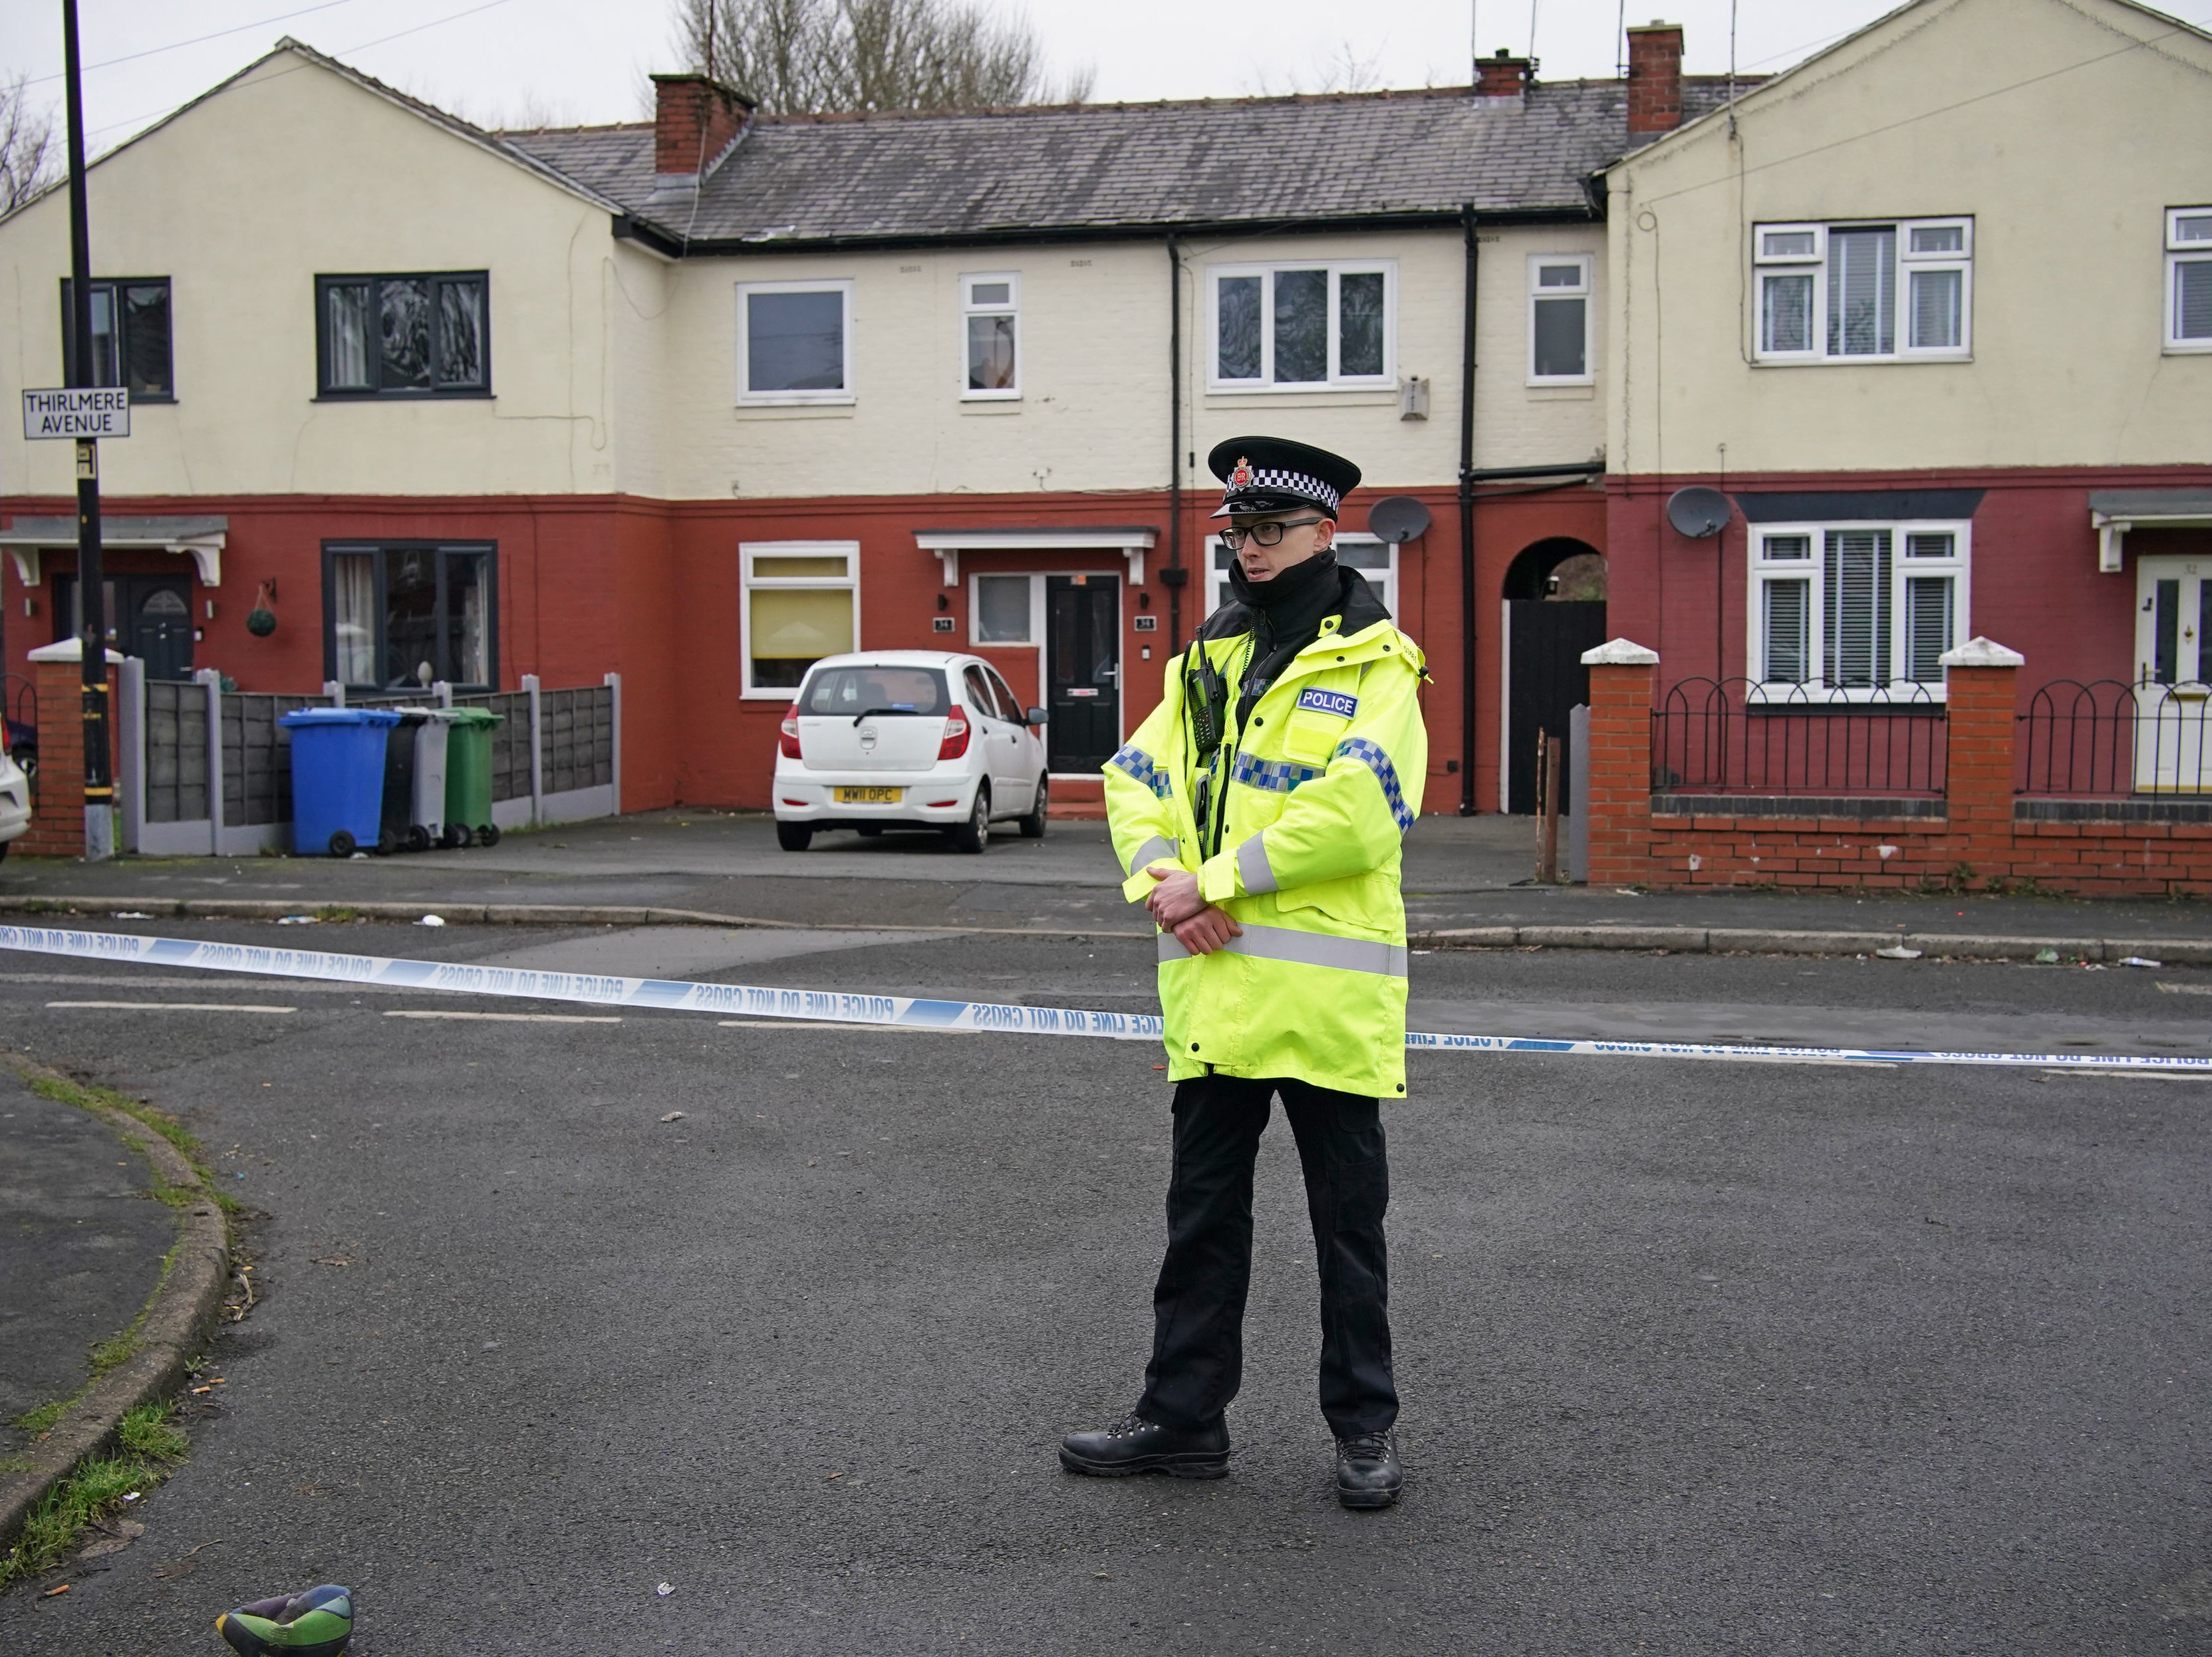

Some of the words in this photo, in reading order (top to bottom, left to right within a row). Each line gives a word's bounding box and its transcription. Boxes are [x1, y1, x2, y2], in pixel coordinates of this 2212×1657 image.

[26, 392, 125, 412] THIRLMERE
[42, 414, 112, 433] AVENUE
[1303, 692, 1354, 714] POLICE
[843, 788, 865, 800] MW11
[869, 789, 892, 800] OPC
